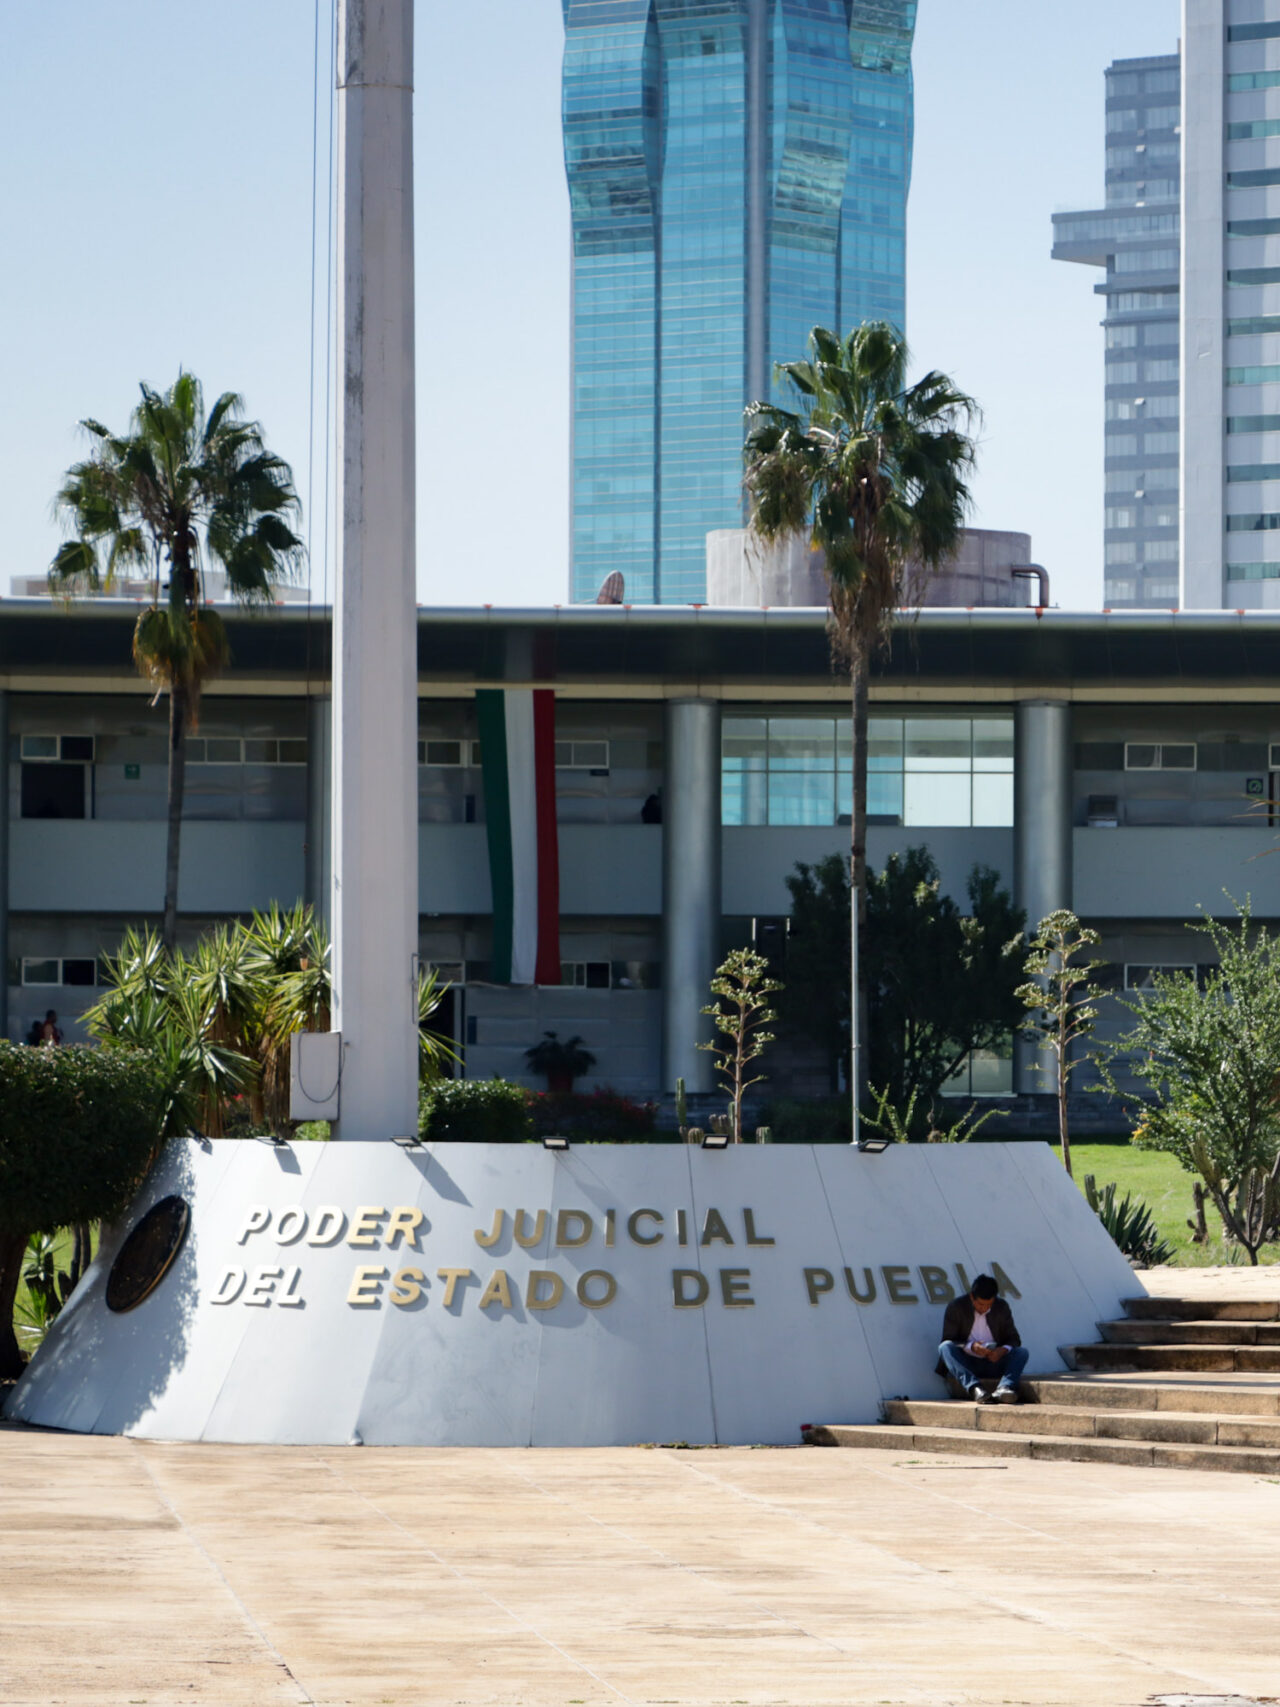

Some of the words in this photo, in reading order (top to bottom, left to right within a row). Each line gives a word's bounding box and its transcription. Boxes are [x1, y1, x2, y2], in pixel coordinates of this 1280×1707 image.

[236, 1204, 424, 1247] PODER
[472, 1207, 776, 1248] JUDICIAL
[210, 1265, 305, 1309] DEL
[346, 1265, 618, 1309] ESTADO
[672, 1268, 755, 1309] DE
